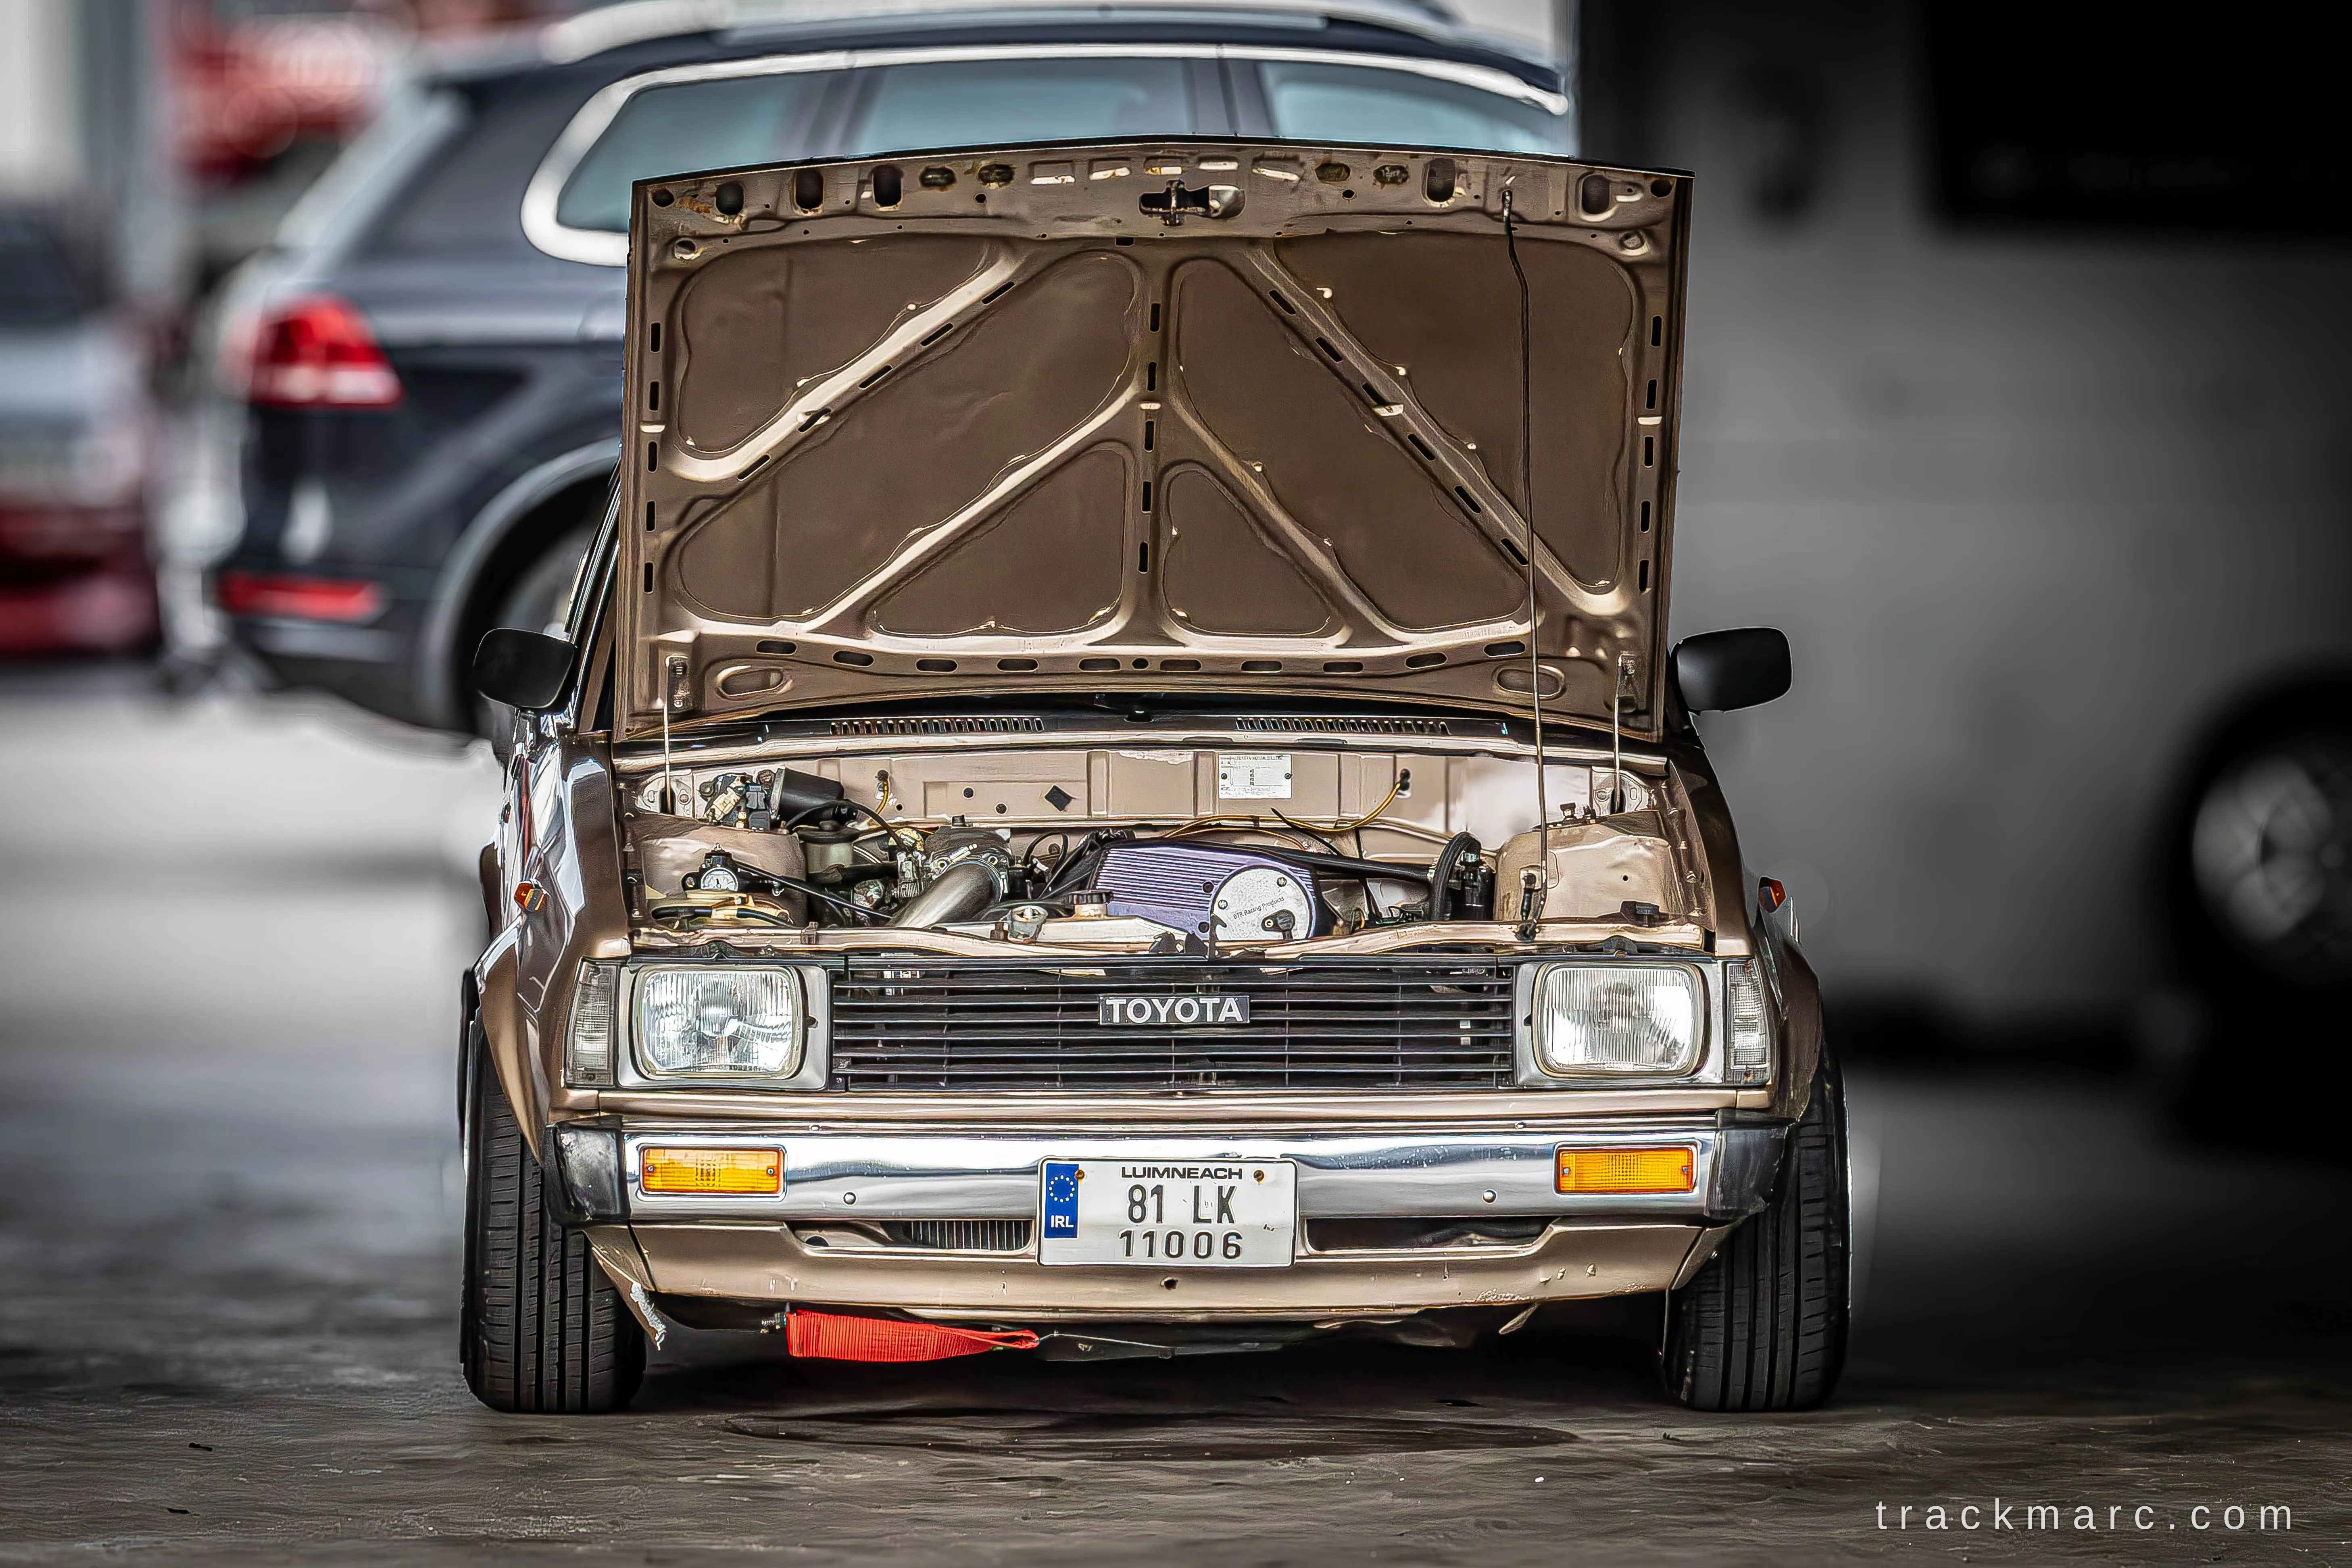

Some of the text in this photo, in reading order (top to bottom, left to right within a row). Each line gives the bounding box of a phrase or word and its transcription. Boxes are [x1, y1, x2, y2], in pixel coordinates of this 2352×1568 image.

[1106, 997, 1243, 1024] TOYOTA
[1121, 1167, 1242, 1180] LUIMNEACH
[1128, 1184, 1236, 1224] 81 LK
[1051, 1215, 1074, 1228] IRL
[1119, 1230, 1242, 1259] 11006
